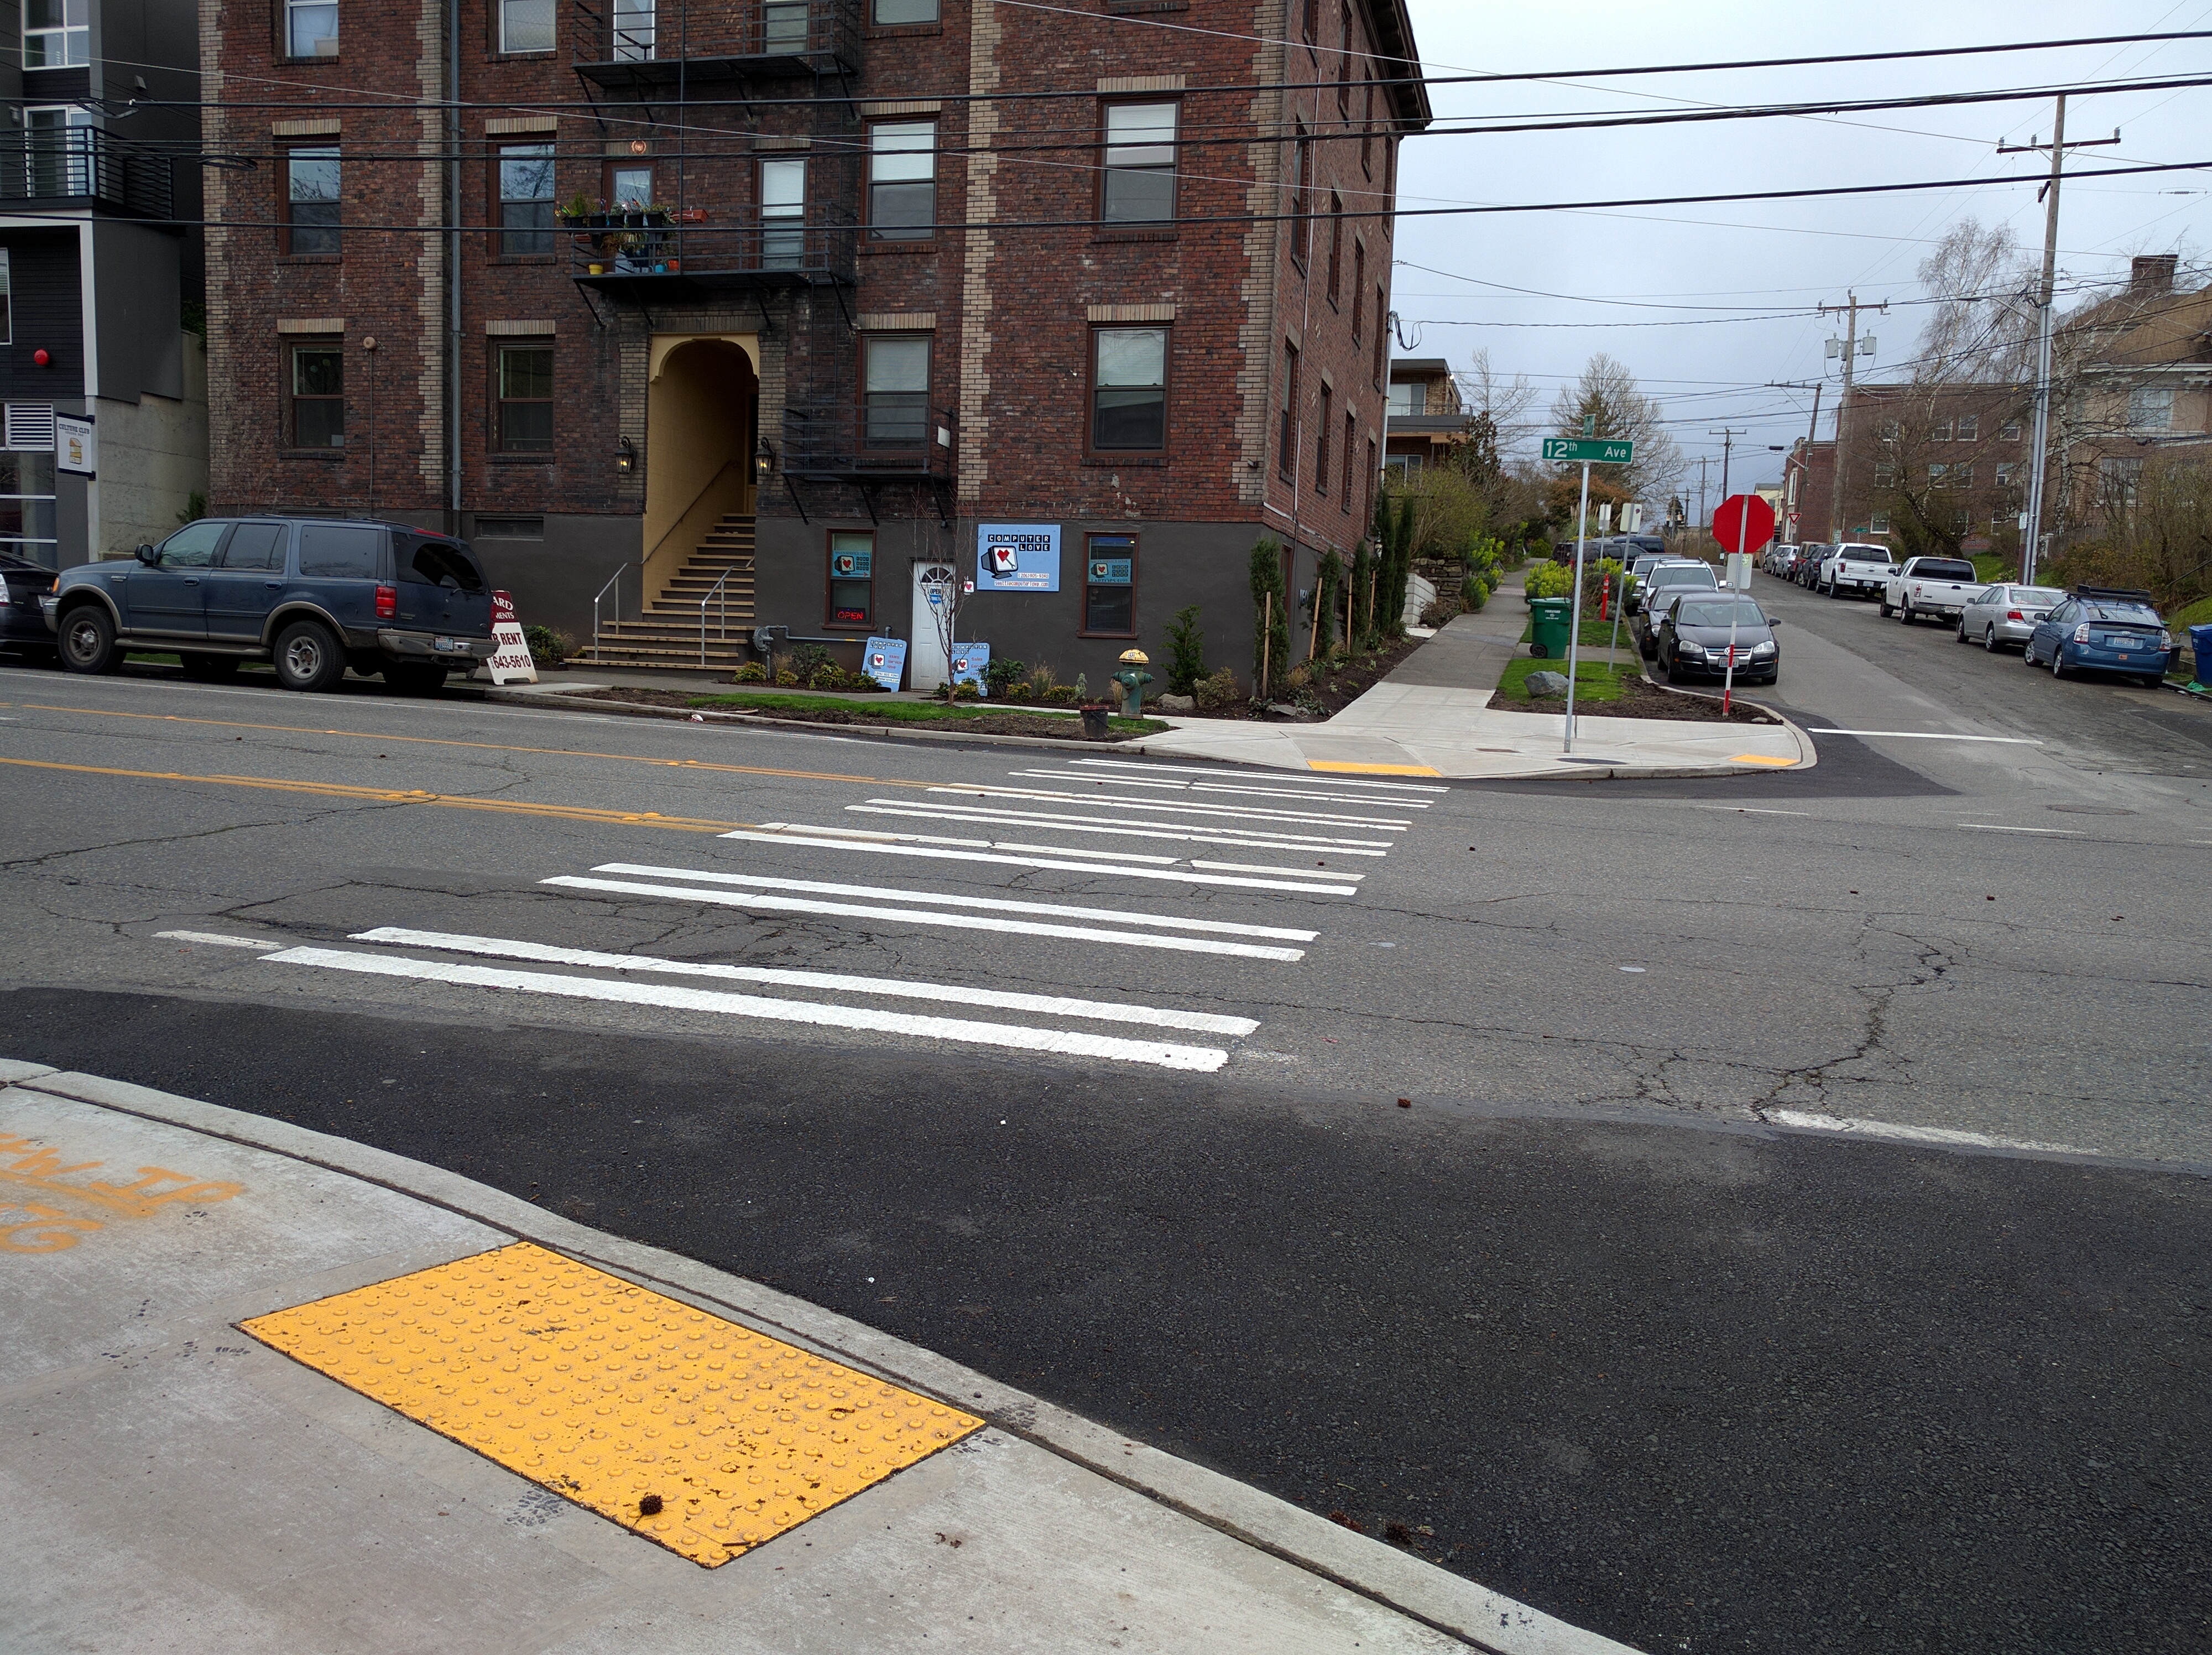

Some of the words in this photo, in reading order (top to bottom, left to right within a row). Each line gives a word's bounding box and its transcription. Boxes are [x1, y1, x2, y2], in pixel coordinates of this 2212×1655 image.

[59, 423, 78, 432] CULTURE
[1547, 441, 1577, 457] 12th
[1604, 446, 1626, 457] Ave
[838, 611, 863, 620] OPEN
[499, 632, 523, 646] RENT
[493, 654, 531, 669] 643-5610
